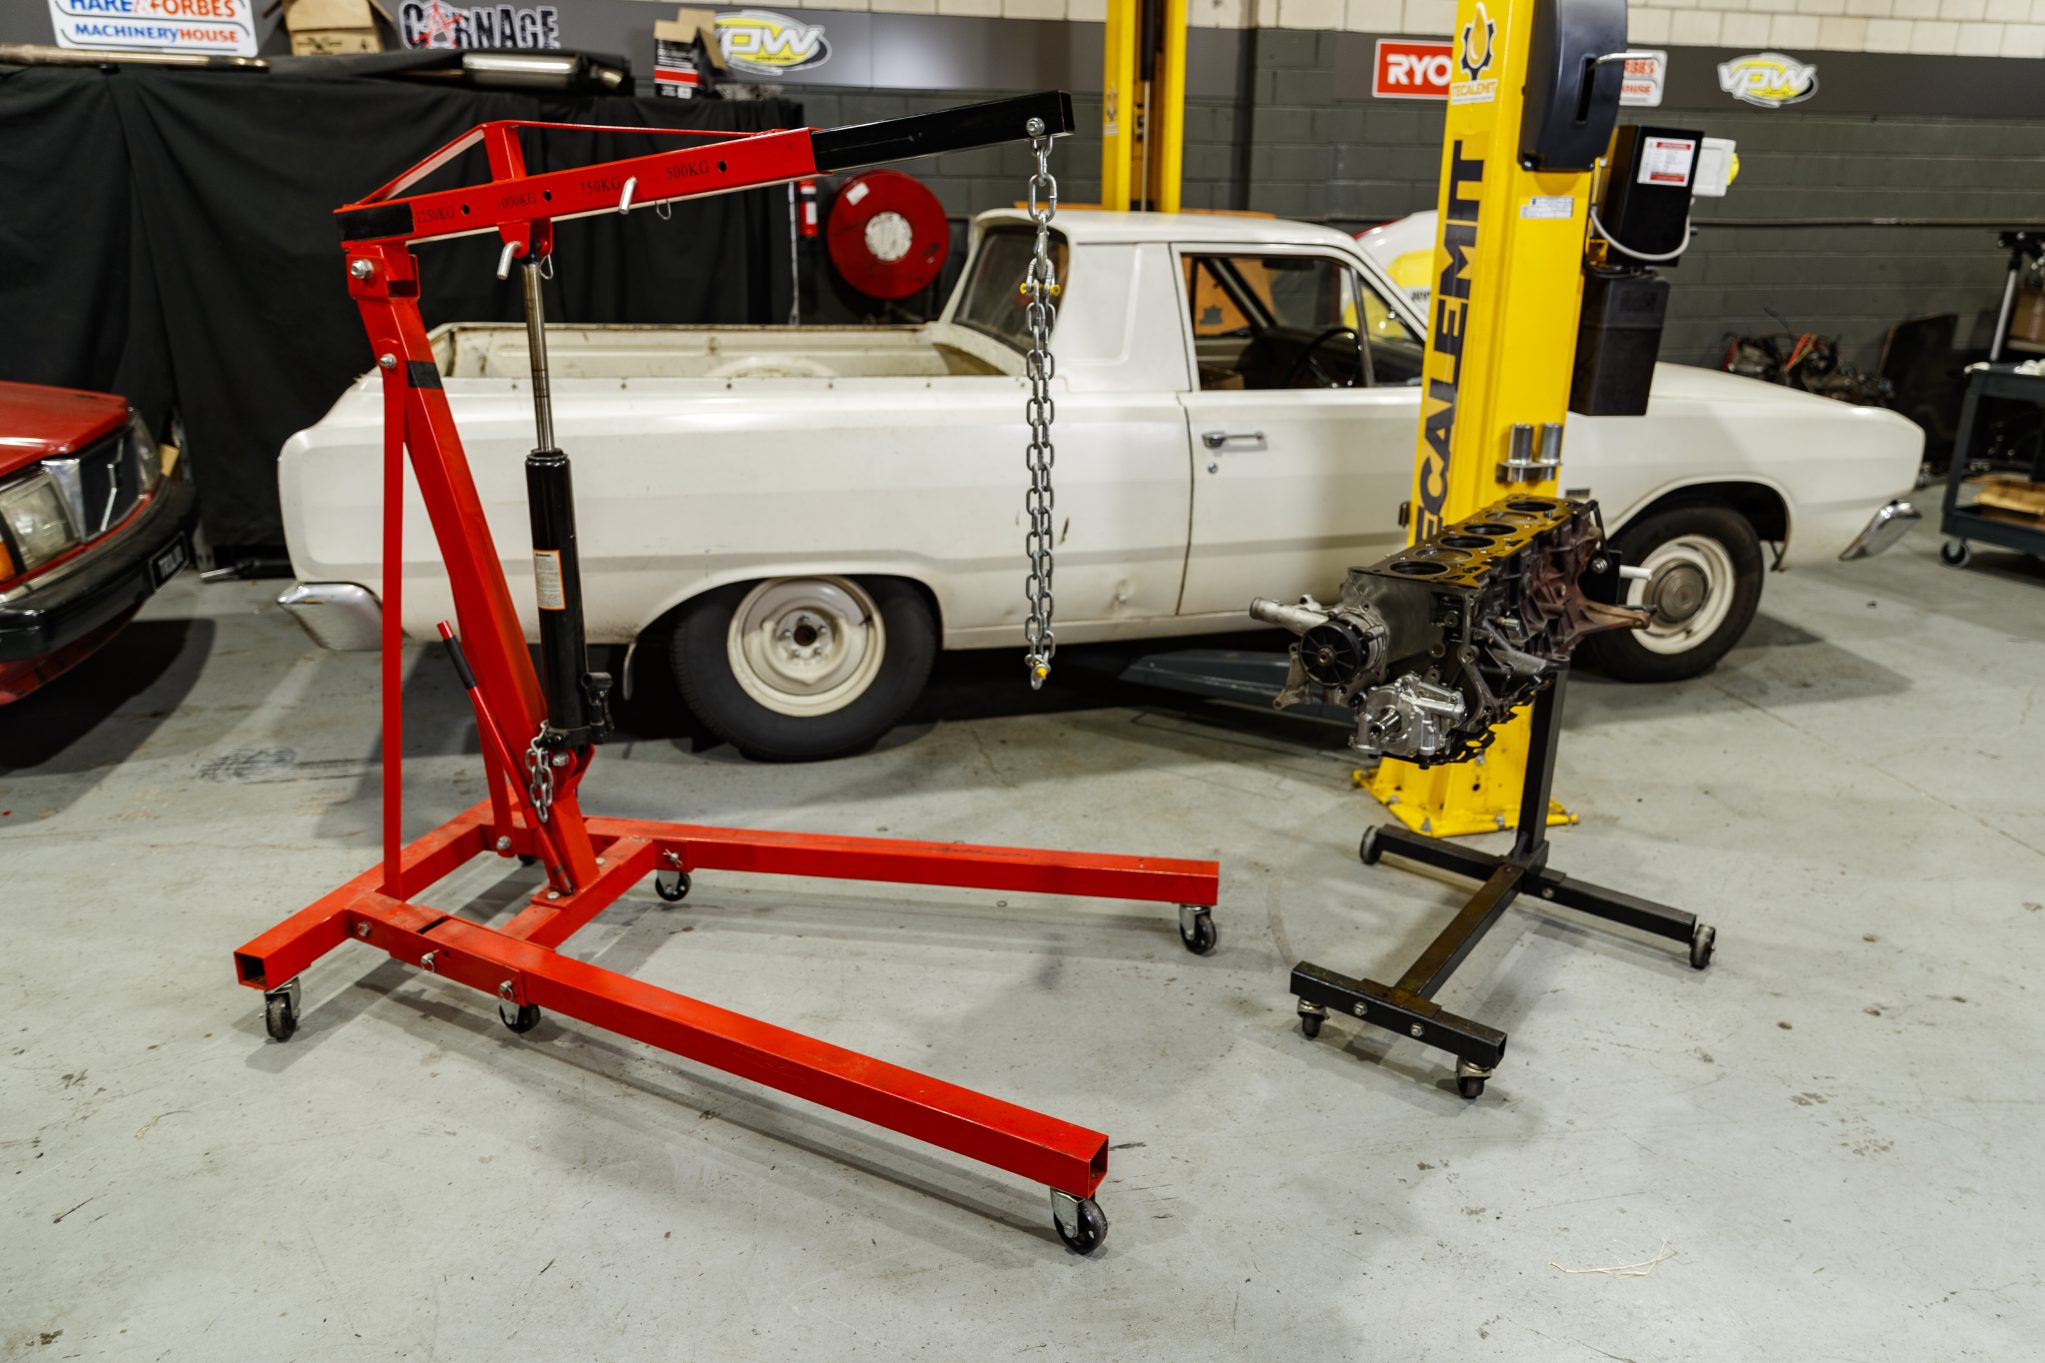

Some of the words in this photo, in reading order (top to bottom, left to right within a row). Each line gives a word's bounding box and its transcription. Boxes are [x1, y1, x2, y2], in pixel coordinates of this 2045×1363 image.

[402, 0, 558, 48] CARNAGE
[718, 26, 824, 62] PW
[1386, 53, 1453, 86] RYO
[579, 176, 621, 195] 750KG
[666, 160, 709, 180] 500KG
[1415, 140, 1485, 545] ECALEMIT
